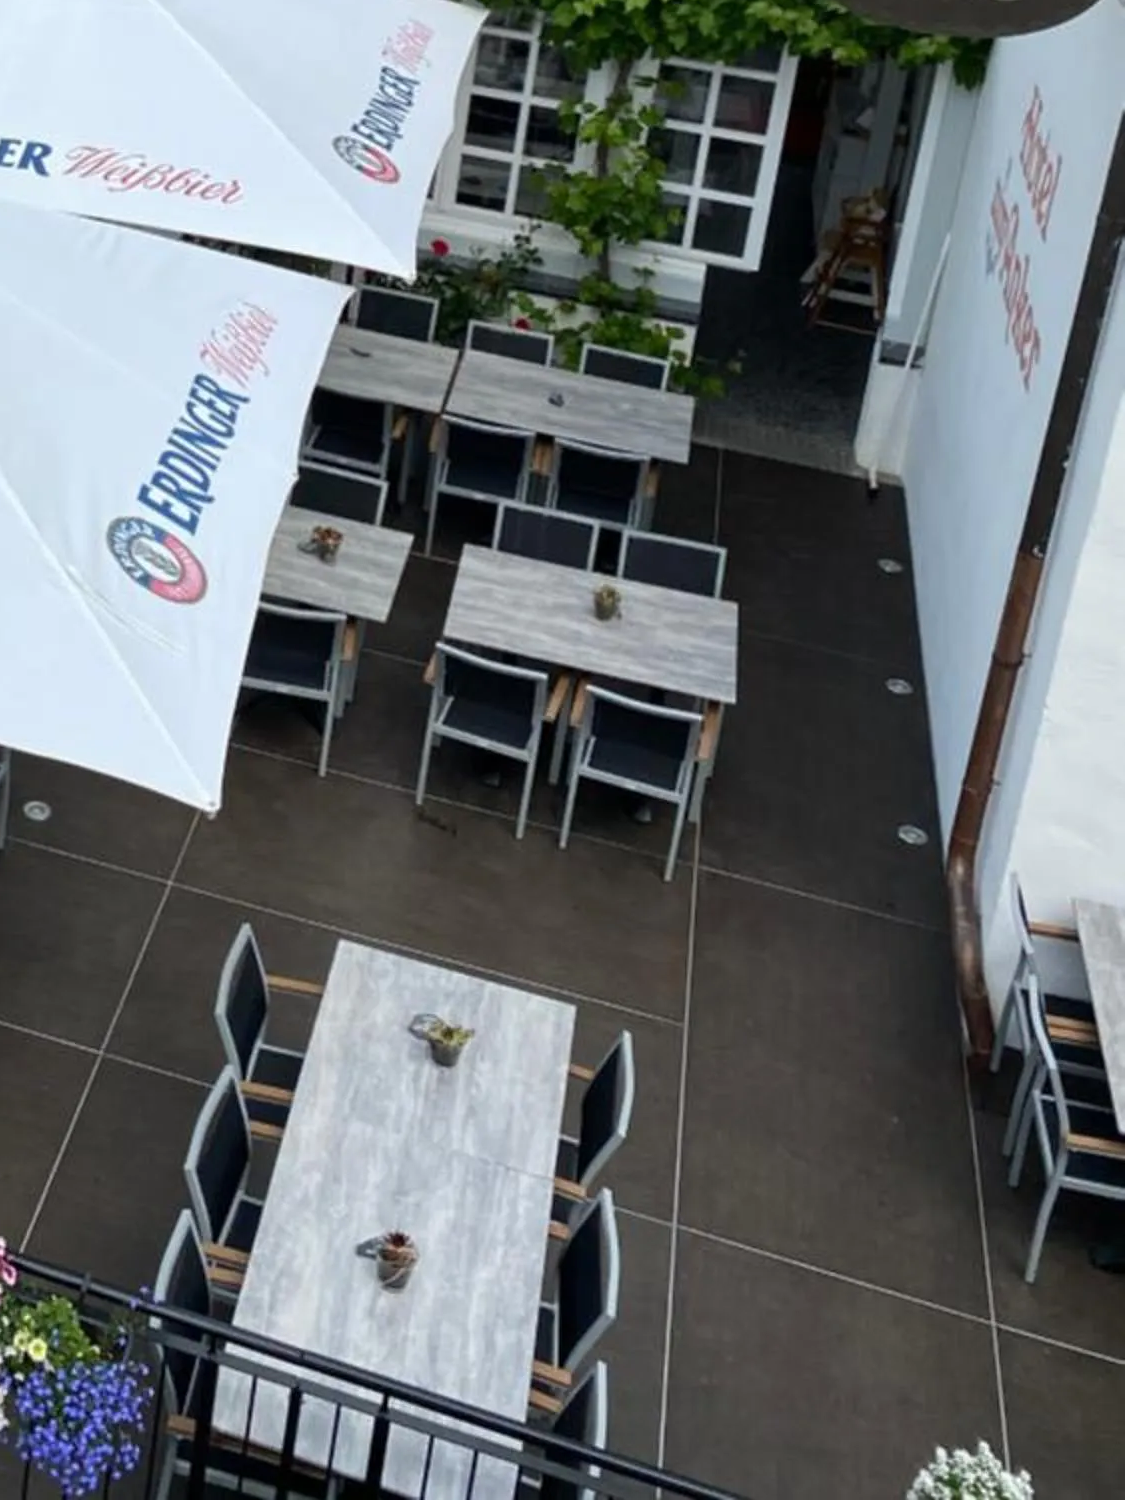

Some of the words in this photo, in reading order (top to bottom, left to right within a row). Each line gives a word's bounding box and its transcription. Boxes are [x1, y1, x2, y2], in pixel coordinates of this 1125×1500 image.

[351, 66, 420, 152] ERDINGER
[62, 145, 244, 205] Weißbier
[137, 373, 251, 536] ERDINGER
